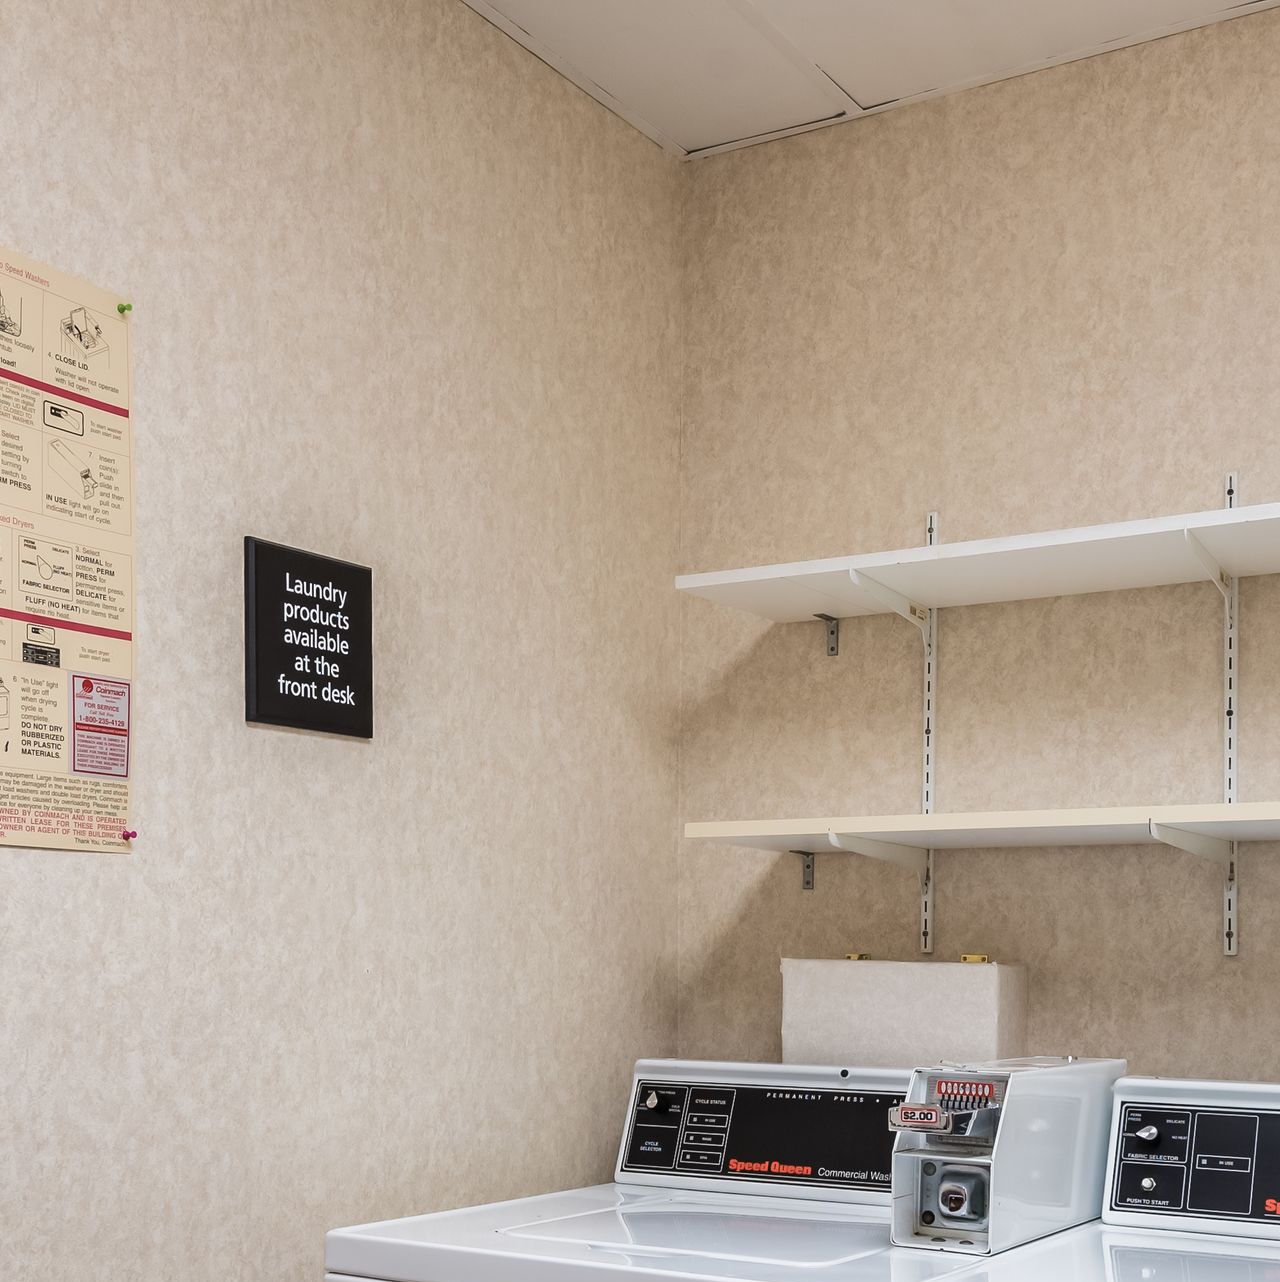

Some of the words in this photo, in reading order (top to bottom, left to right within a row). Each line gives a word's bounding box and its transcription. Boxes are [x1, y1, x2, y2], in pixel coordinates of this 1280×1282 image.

[4, 262, 23, 276] Speed
[24, 270, 49, 287] Washers
[54, 353, 76, 366] CLOSE
[9, 479, 31, 490] PRESS
[45, 493, 52, 501] IN
[54, 495, 67, 505] USE
[69, 500, 80, 508] light
[12, 516, 34, 529] Dryers
[22, 579, 41, 588] FABRIC
[43, 583, 69, 593] SELECTOR
[286, 572, 347, 608] Laundry
[25, 595, 46, 605] FLUFF
[61, 603, 80, 613] HEAT)
[283, 602, 349, 629] products
[284, 628, 348, 654] available
[294, 654, 310, 672] at
[314, 655, 339, 677] the
[95, 686, 125, 696] Coinmach
[277, 673, 317, 699] front
[321, 681, 355, 705] desk
[97, 704, 119, 712] SERVICE
[21, 730, 64, 741] RUBBERIZED
[33, 740, 61, 750] PLASTIC
[34, 810, 69, 819] COINMACH
[95, 815, 126, 824] OPERATED
[903, 1111, 932, 1120] $2.00
[728, 1158, 769, 1171] Speed
[770, 1161, 811, 1174] Queen
[817, 1167, 868, 1179] Commercial
